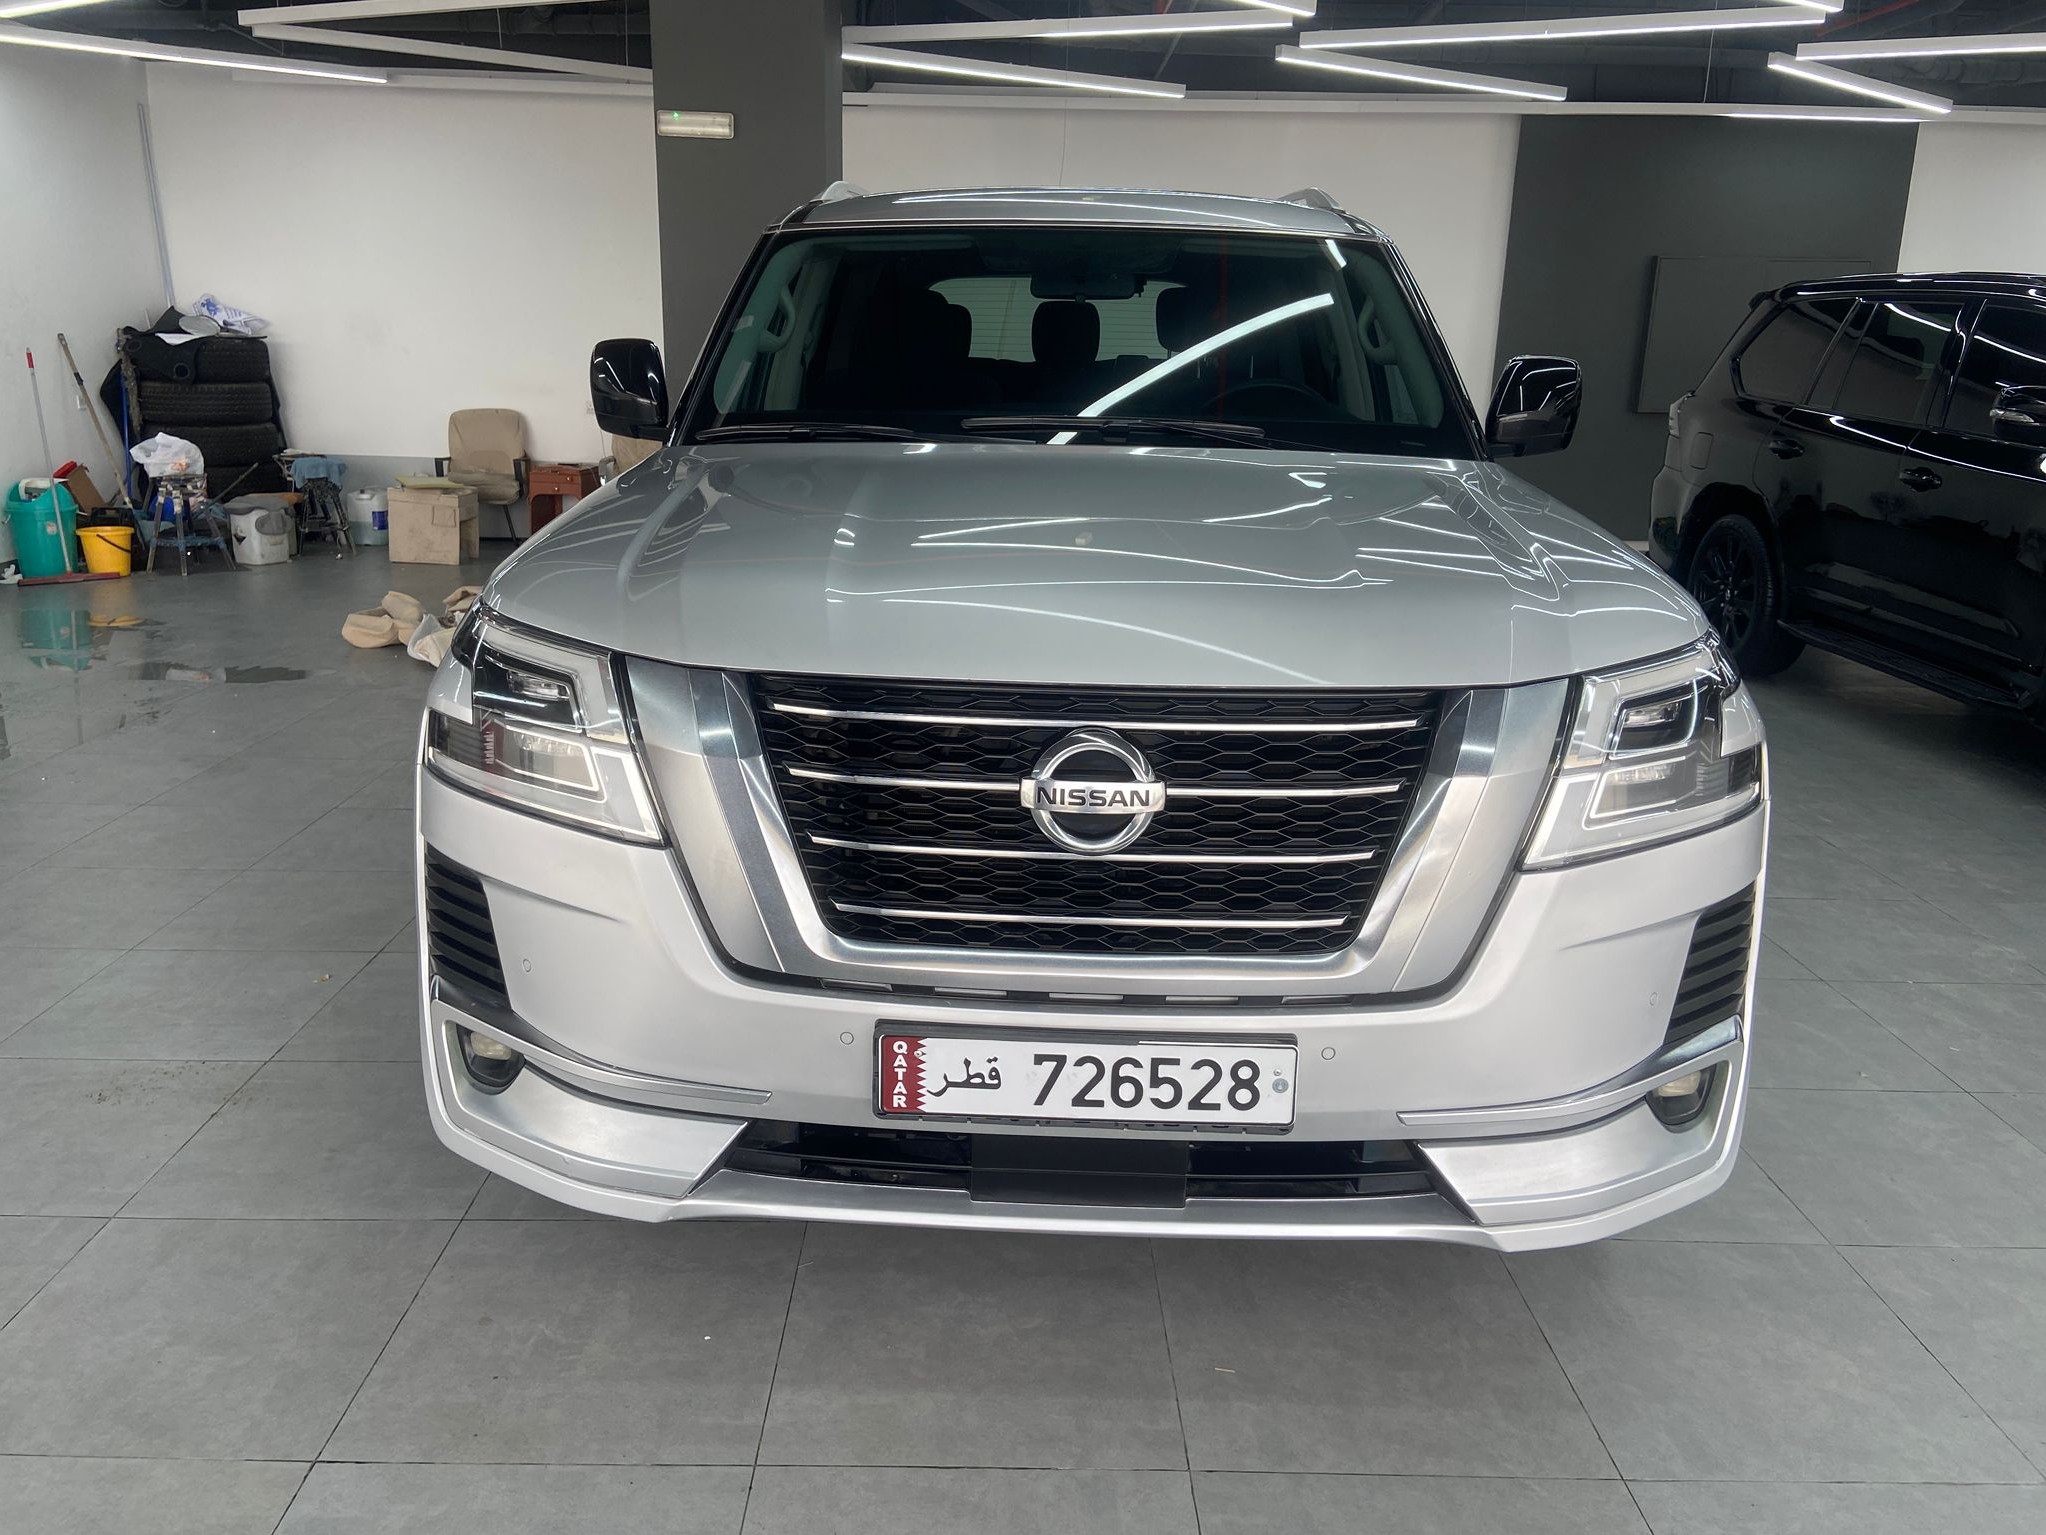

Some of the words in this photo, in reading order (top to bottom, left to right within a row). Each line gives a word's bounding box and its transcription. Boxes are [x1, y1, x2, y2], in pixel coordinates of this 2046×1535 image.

[1036, 787, 1150, 807] NISSAN
[892, 1040, 908, 1108] QATAR
[926, 1056, 1002, 1097] قطر
[1033, 1053, 1260, 1111] 726528
